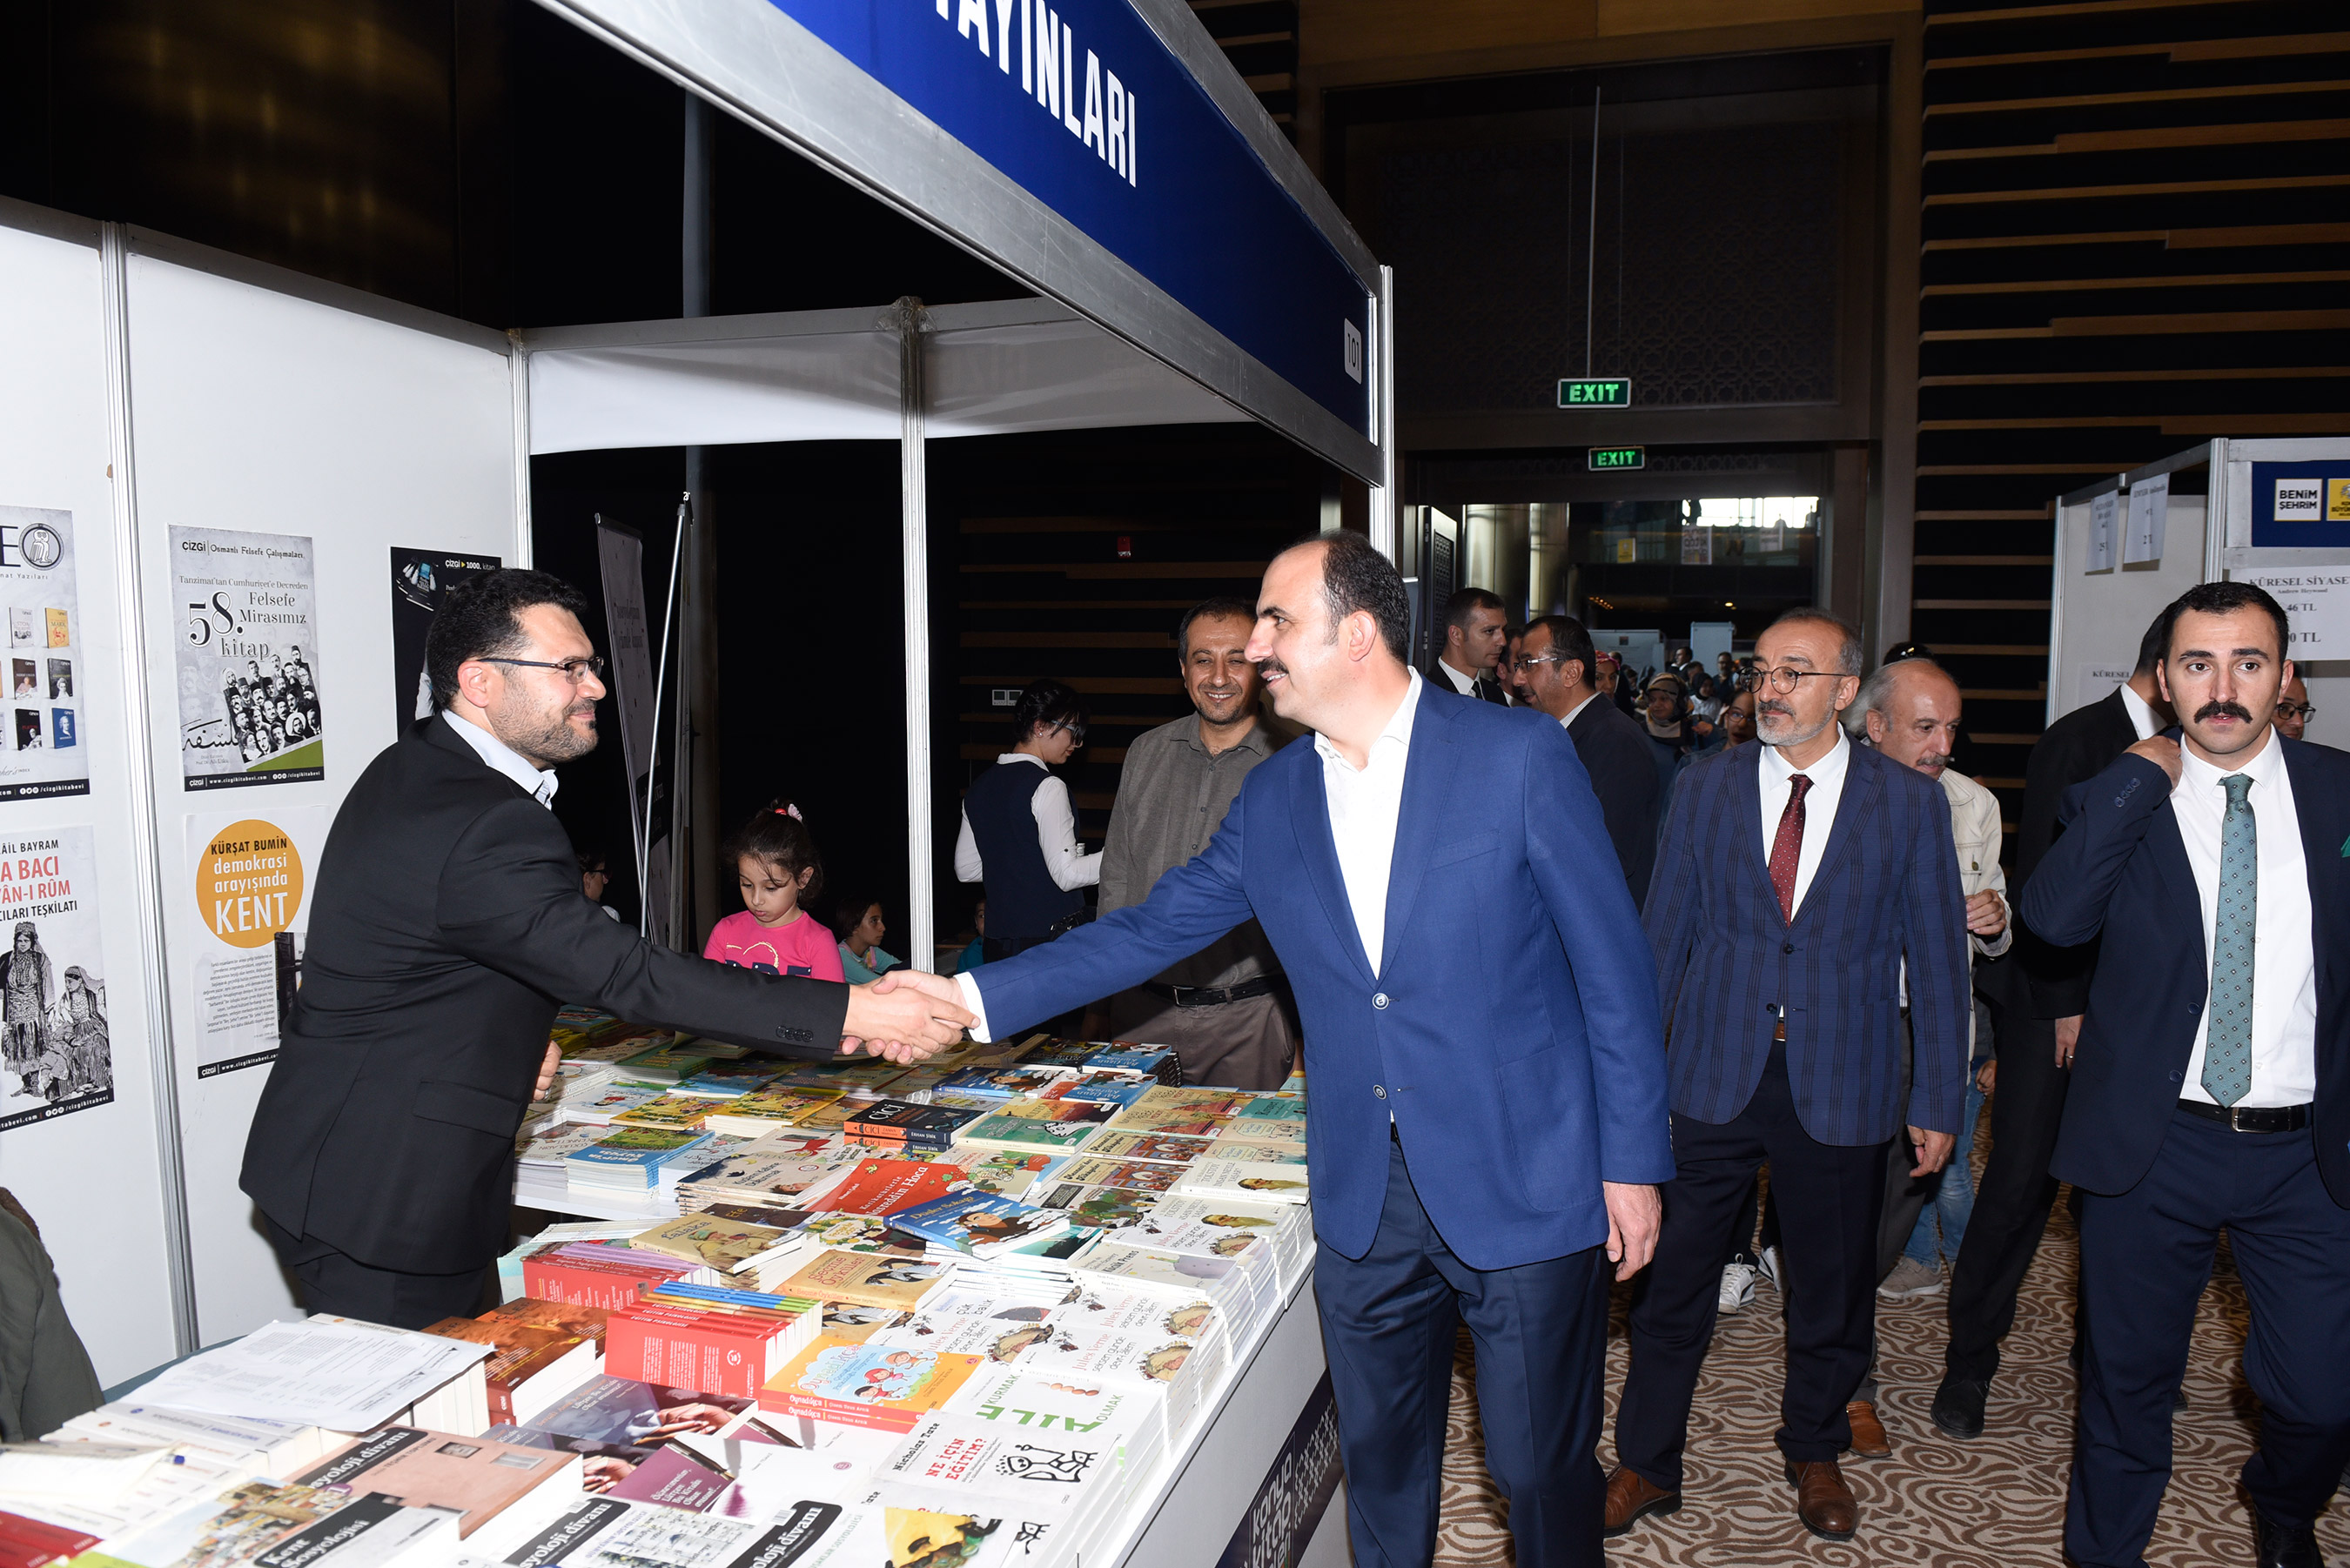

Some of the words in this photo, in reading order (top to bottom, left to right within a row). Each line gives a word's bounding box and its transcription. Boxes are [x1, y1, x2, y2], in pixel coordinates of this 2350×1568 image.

[936, 0, 1136, 188] AYINLARI
[1347, 332, 1360, 371] 101
[1569, 384, 1619, 402] EXIT
[1597, 451, 1635, 466] EXIT
[211, 544, 238, 554] Osmanlı
[241, 546, 263, 556] Felsefe
[2250, 577, 2303, 587] KÜRESEL
[2306, 575, 2350, 586] SİYASE
[249, 592, 295, 606] Felsefe
[189, 592, 244, 646] 58.
[239, 609, 306, 624] Mirasımız
[221, 638, 269, 660] kitap
[2300, 633, 2320, 642] TL
[2, 842, 17, 854] ÂİL
[20, 839, 59, 853] BAYRAM
[211, 841, 250, 855] KÜRŞAT
[254, 835, 287, 851] BUMİN
[18, 855, 59, 880] BACI
[213, 853, 286, 874] demokrasi
[0, 884, 33, 904] ÂN-I
[38, 878, 70, 899] RÛM
[214, 870, 288, 895] arayışında
[0, 908, 29, 921] ILARI
[30, 900, 77, 918] TEŞKİLATI
[215, 892, 288, 935] KENT
[901, 1166, 929, 1187] Hoca
[808, 1256, 847, 1282] Seçme
[822, 1256, 865, 1286] Öyküler
[957, 1303, 974, 1316] çük
[1087, 1333, 1111, 1351] Verne
[789, 1395, 822, 1407] Oynadıkça
[987, 1373, 1021, 1405] KURMAK
[789, 1406, 821, 1419] Oynadıkça
[1096, 1394, 1124, 1422] OLMAK
[892, 1436, 925, 1472] Nicholas
[921, 1422, 940, 1443] Tate
[925, 1464, 945, 1478] NE
[936, 1437, 965, 1462] İÇİN
[945, 1438, 987, 1481] EĞİTİM?
[310, 1456, 361, 1489] syoloji
[359, 1431, 411, 1460] divanı
[861, 1491, 881, 1505] ate
[1253, 1452, 1292, 1544] konya
[280, 1519, 371, 1568] Sosyolojisi
[520, 1531, 568, 1568] syoloji
[566, 1503, 613, 1536] divanı
[749, 1543, 785, 1568] oloji
[783, 1506, 823, 1548] divanı
[263, 1538, 312, 1565] Kent
